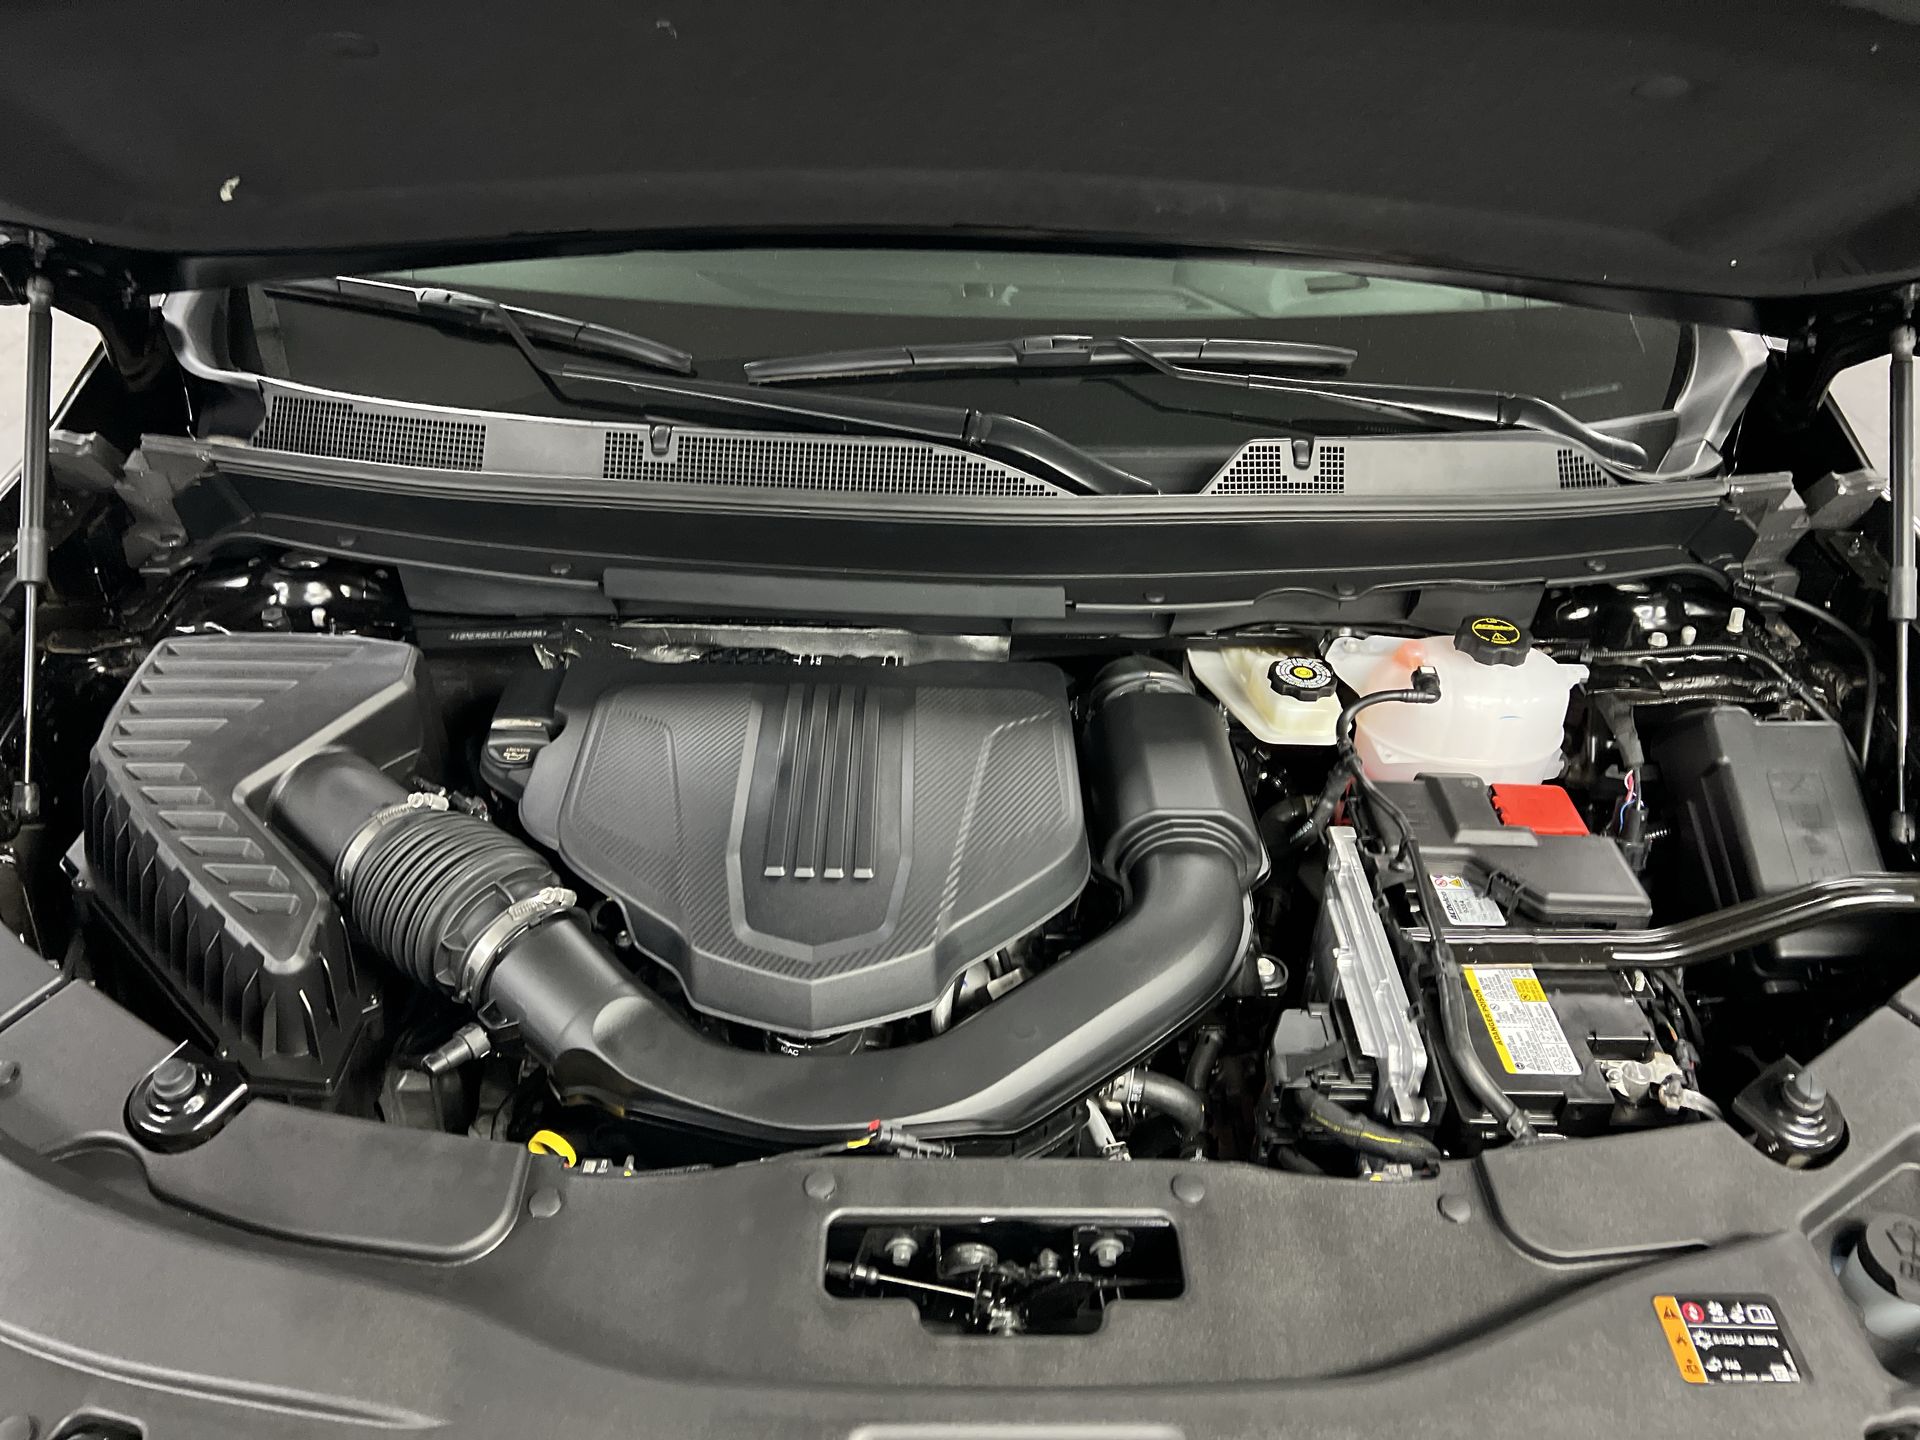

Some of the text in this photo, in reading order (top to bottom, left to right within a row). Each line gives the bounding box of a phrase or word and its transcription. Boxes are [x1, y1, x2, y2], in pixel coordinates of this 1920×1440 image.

[1440, 891, 1459, 921] ACDelco
[1474, 989, 1501, 1041] DANGER POISON
